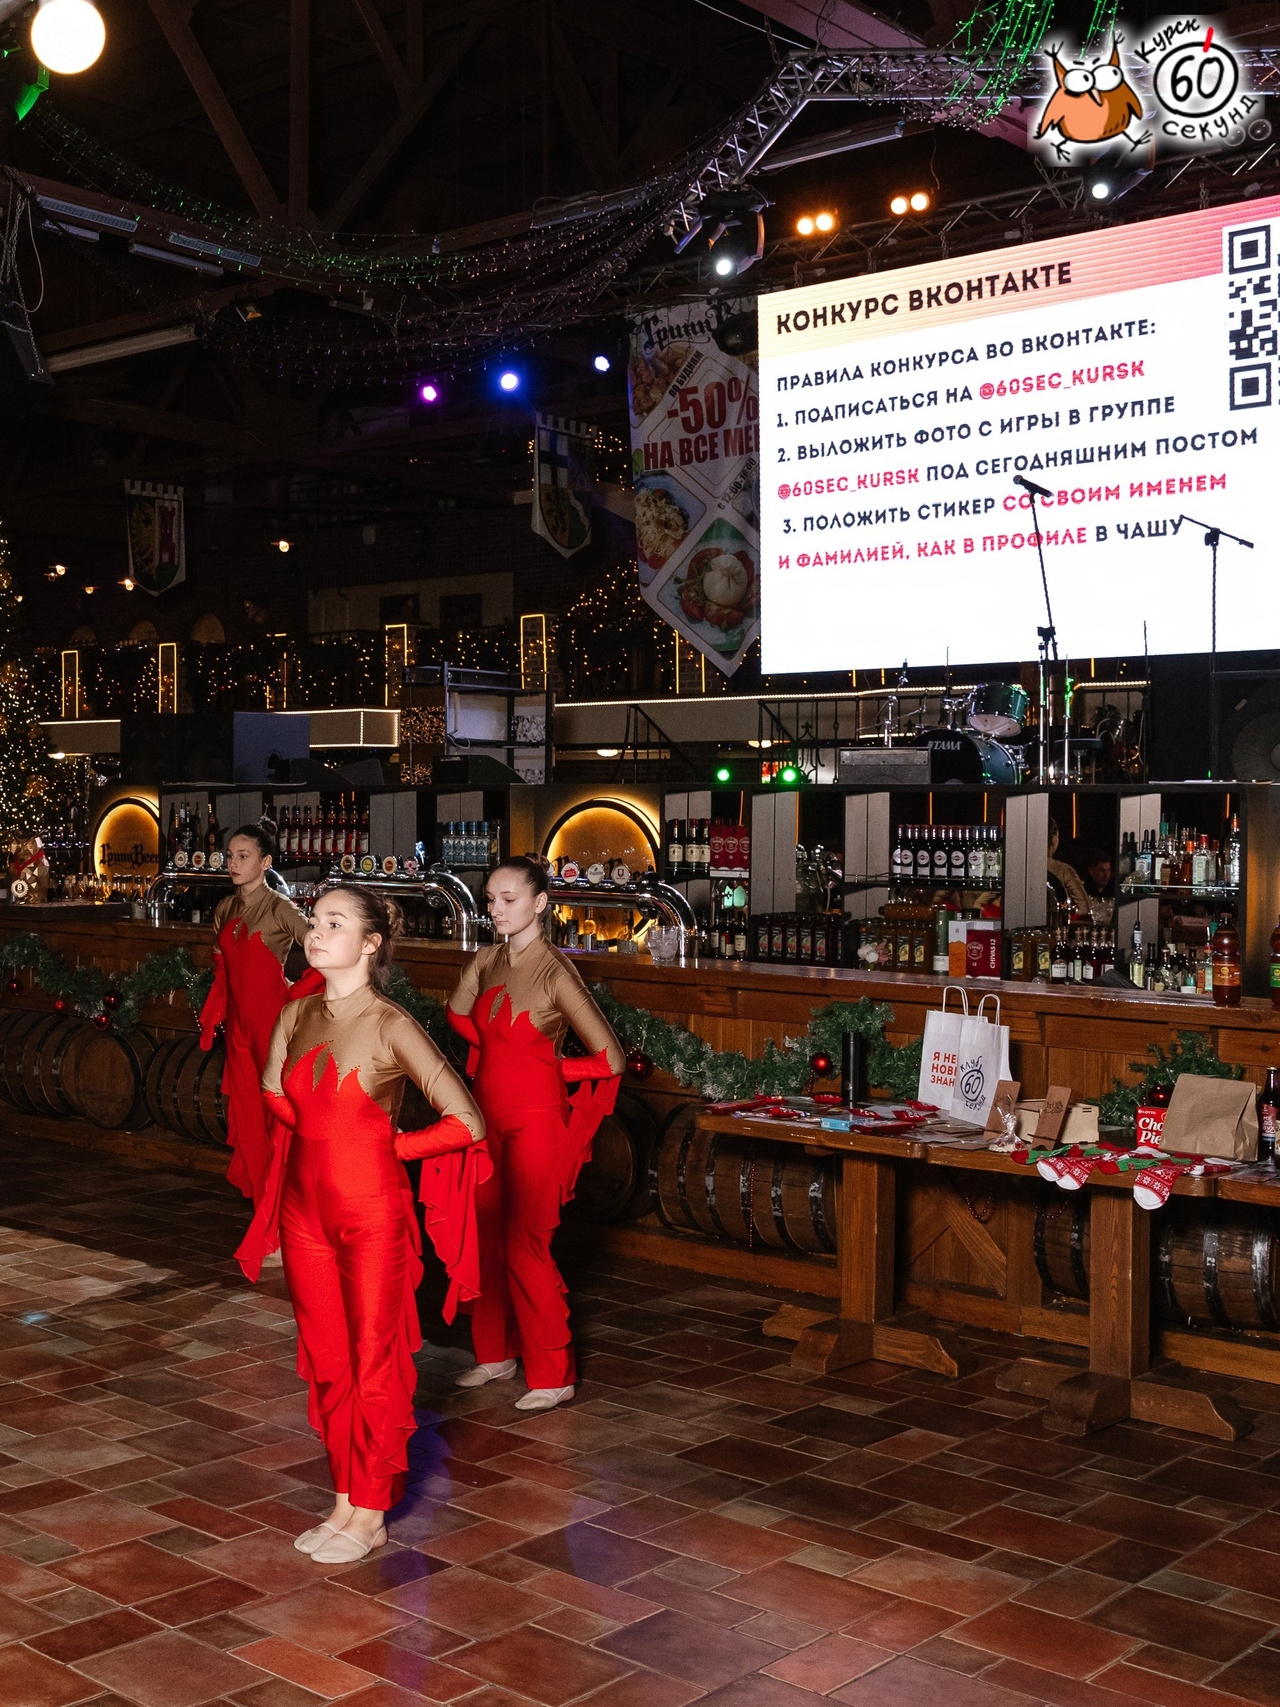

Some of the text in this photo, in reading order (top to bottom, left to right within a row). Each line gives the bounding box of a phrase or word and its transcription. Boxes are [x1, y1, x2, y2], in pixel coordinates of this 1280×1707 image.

[777, 294, 898, 334] КОНКУРС
[909, 261, 1071, 311] ВКОНТАКТЕ
[677, 350, 704, 388] БУДНЯМ
[778, 319, 1155, 391] ПРАВИЛА КОНКУРСА ВО ВКОНТАКТЕ:
[667, 374, 758, 434] -50%
[777, 361, 1144, 427] 1. ПОДПИСАТЬСЯ НА @60SEC_KURSK
[644, 441, 674, 470] НА
[679, 432, 719, 466] ВСЕ
[778, 396, 1174, 462] 2. ВЫЛОЖИТЬ ФОТО С ИГРЫ В ГРУППЕ
[778, 428, 1256, 499] @60SEC_KURSK ПОД СЕГОДНЯШНИМ ПОСТОМ
[783, 474, 1225, 533] 3. ПОЛОЖИТЬ СТИКЕР СО СВОИМ ИМЕНЕМ
[779, 518, 1184, 569] И ФАМИЛИЕЙ, КАК В ПРОФИЛЕ В ЧАШУ
[932, 740, 962, 750] TAMA
[933, 1051, 957, 1064] Я НЕ
[964, 1074, 981, 1095] 60
